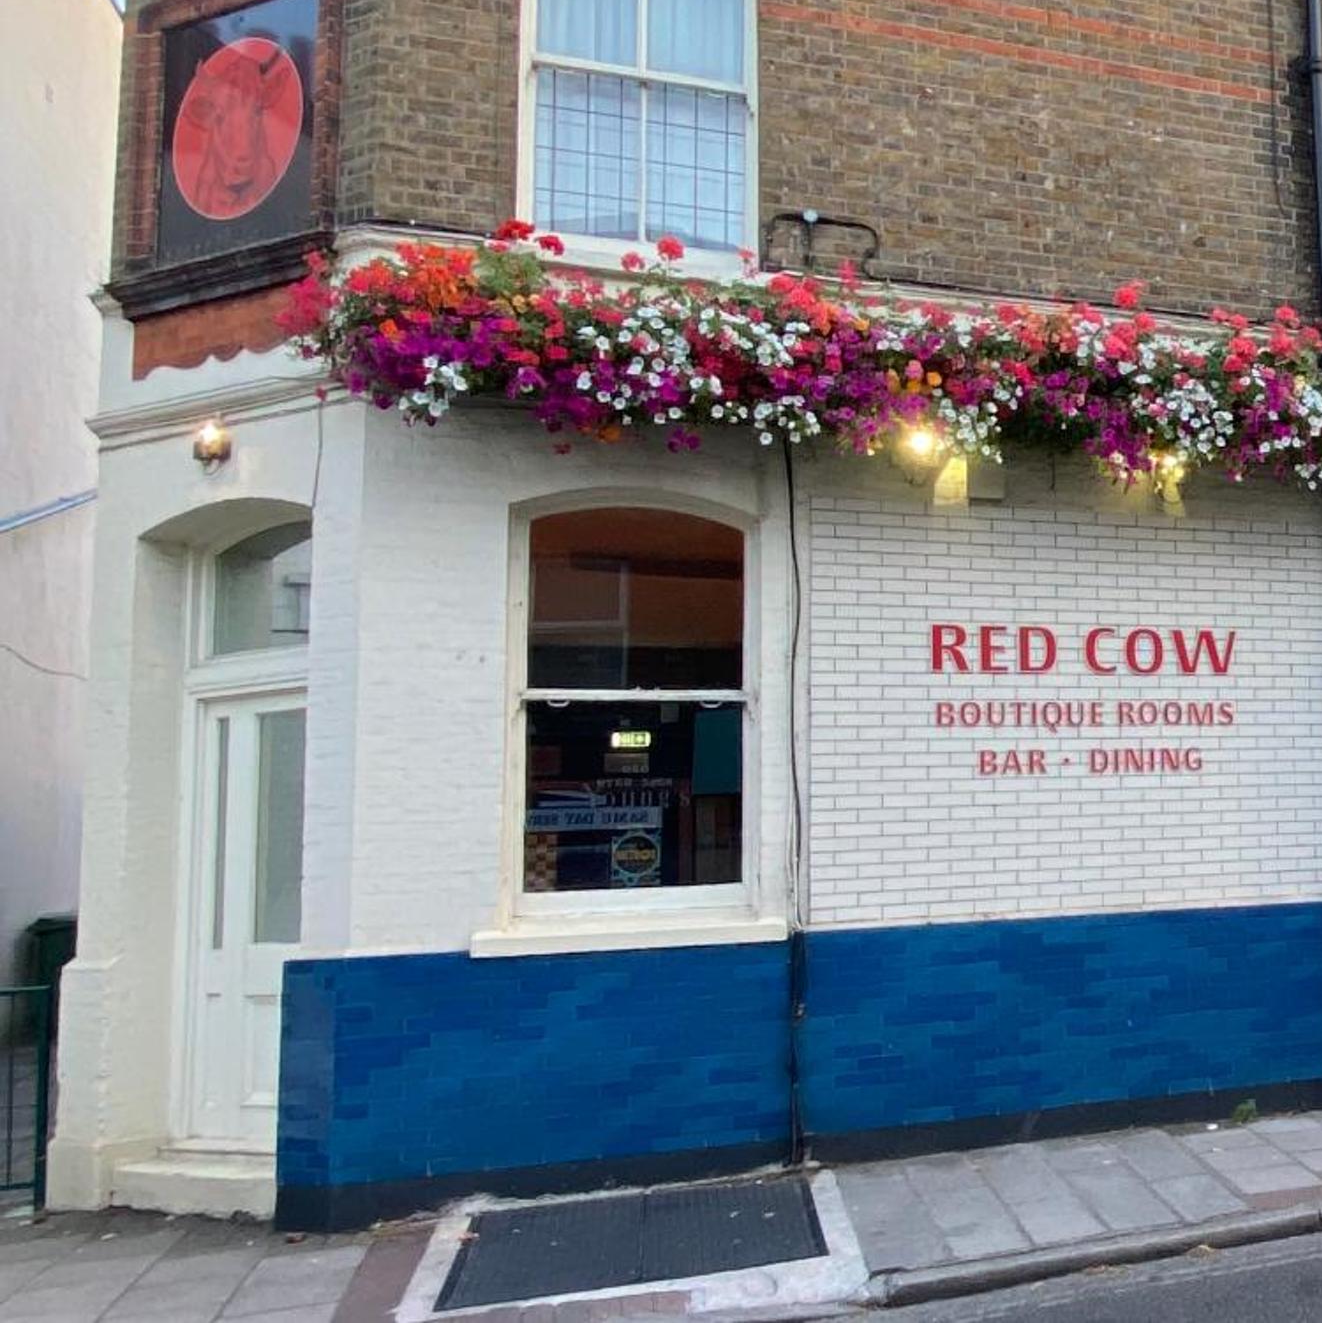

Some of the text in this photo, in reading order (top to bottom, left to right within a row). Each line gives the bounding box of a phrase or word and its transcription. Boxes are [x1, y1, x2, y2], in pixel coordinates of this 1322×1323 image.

[930, 623, 1237, 677] RED COW
[935, 700, 1235, 733] BOUTIQUE ROOMS
[978, 746, 1203, 776] BAR DINING
